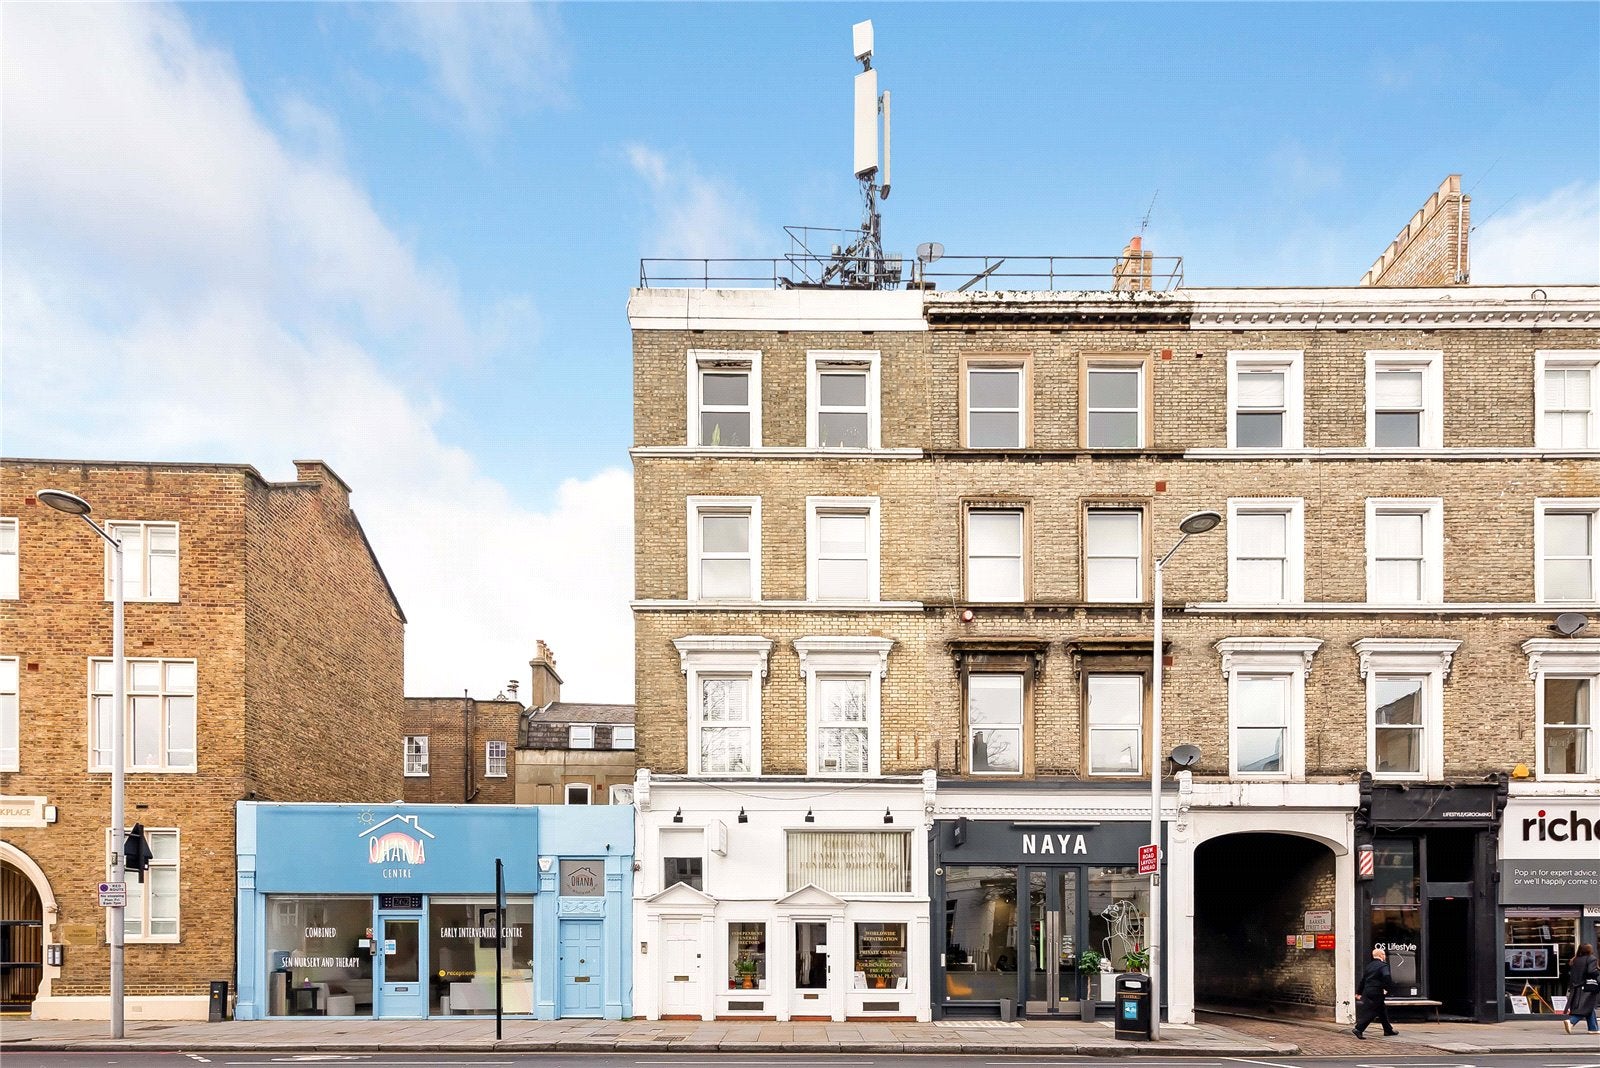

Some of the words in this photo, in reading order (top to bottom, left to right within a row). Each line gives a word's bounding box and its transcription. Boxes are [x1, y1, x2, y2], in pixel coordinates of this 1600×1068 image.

[369, 836, 426, 863] OHANA
[1022, 834, 1088, 855] NAYA
[382, 869, 411, 878] CENTRE
[1514, 869, 1529, 877] Pop
[571, 875, 594, 887] OHANA
[1541, 878, 1566, 886] happily
[305, 927, 337, 938] COMBINED
[440, 928, 457, 938] EARLY
[458, 928, 502, 938] INTERVENTIO
[502, 928, 523, 938] CENTRE
[1387, 943, 1417, 951] Lifestyle
[281, 957, 293, 968] SEN
[294, 957, 320, 968] NURSERY
[321, 957, 334, 968] AND
[335, 957, 360, 968] THERAPY
